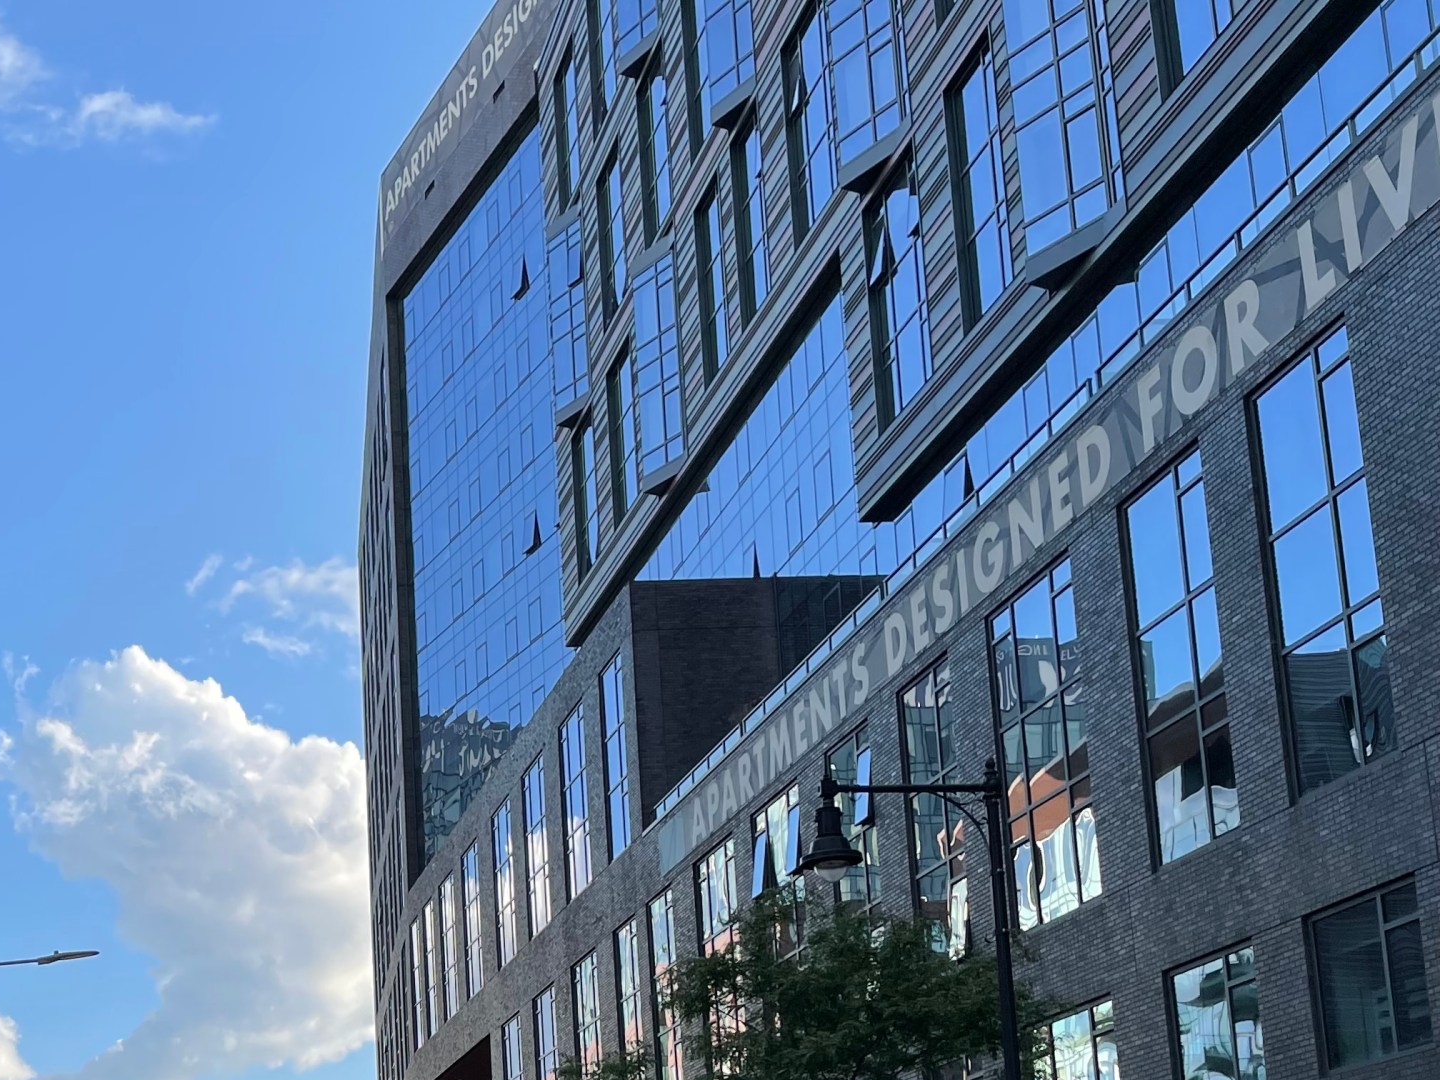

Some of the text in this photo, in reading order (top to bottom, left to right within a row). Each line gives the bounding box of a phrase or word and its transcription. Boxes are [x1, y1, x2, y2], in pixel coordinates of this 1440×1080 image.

[384, 0, 539, 221] APARTMENTS DESIG
[692, 642, 869, 846] APARTMENTS
[883, 424, 1111, 677] DESIGNED
[1137, 279, 1270, 454] FOR
